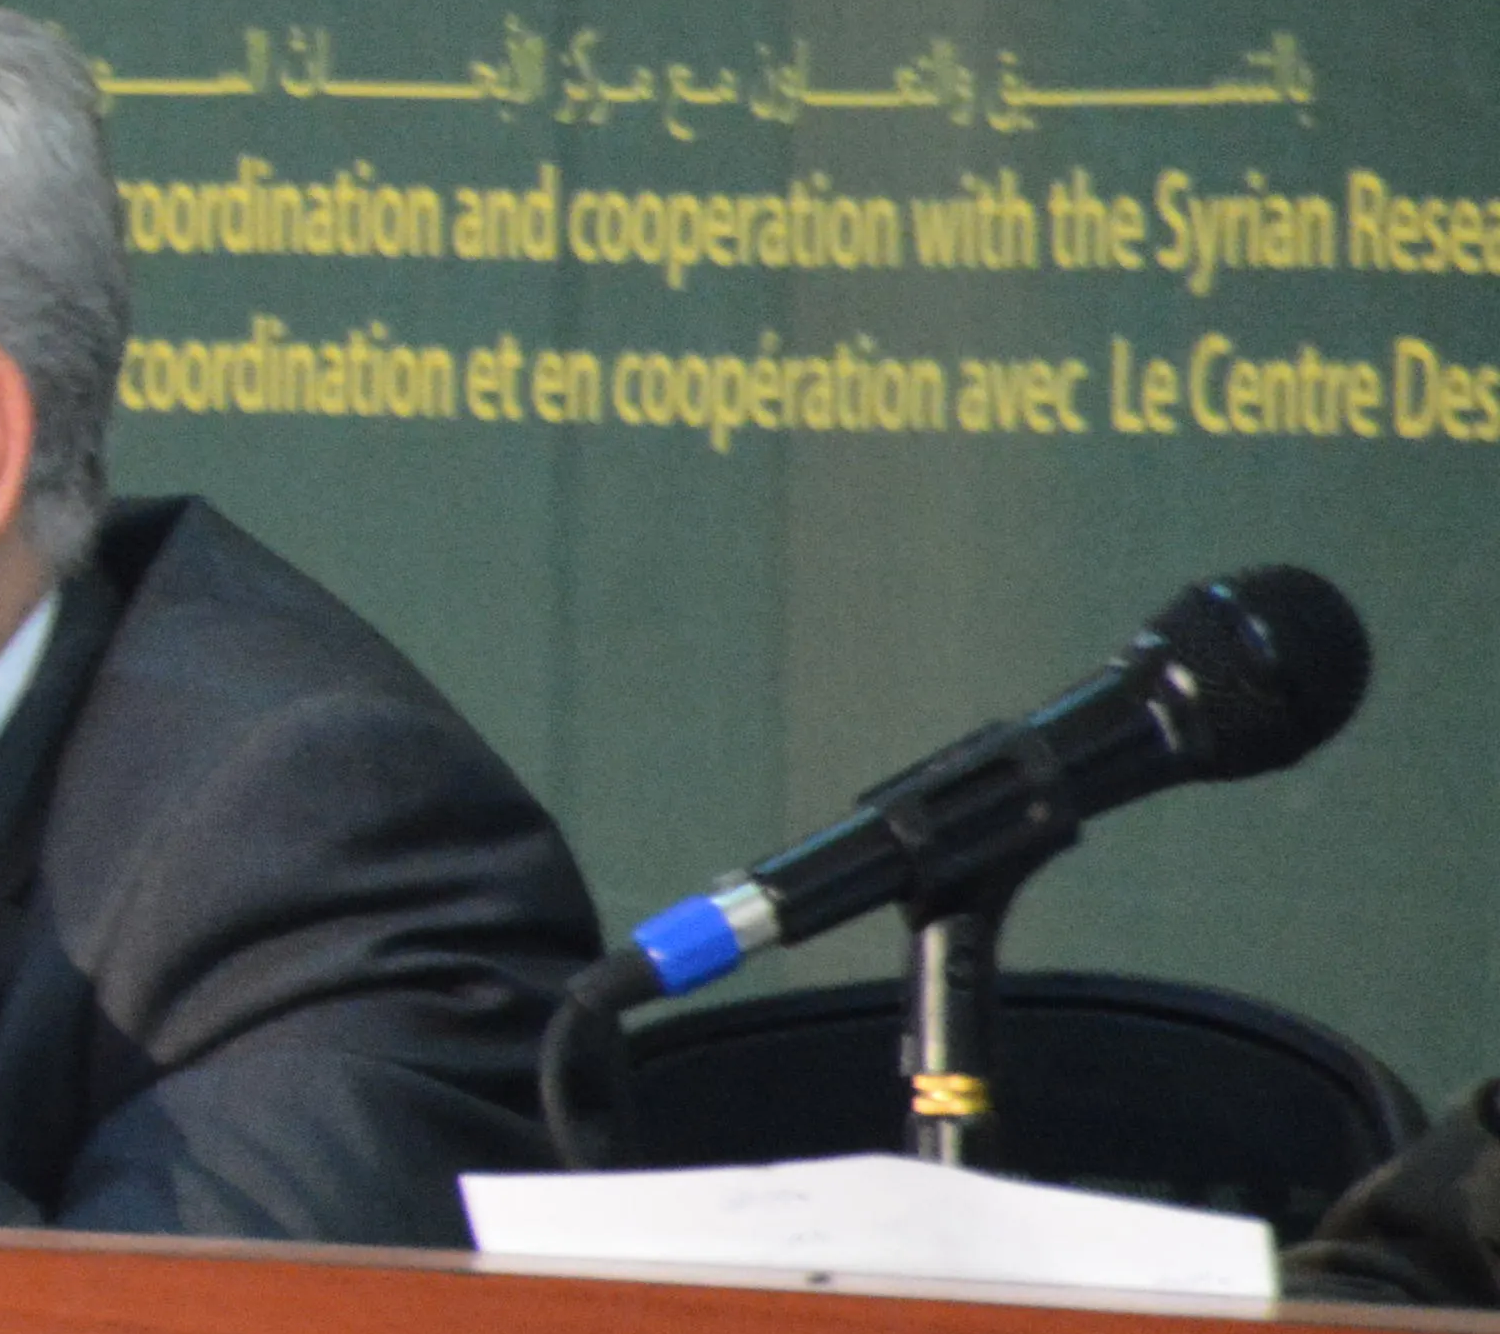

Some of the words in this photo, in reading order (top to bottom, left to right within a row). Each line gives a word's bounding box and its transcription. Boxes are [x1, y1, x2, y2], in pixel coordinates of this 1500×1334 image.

[452, 166, 559, 261] and
[568, 176, 902, 287] cooperation
[911, 171, 1038, 269] with
[1047, 174, 1145, 269] the
[1156, 171, 1335, 294] Syrian
[465, 336, 524, 420] et
[531, 351, 602, 423] en
[955, 359, 1086, 433] avec
[1112, 342, 1178, 433] Le
[1190, 333, 1383, 436] Centre
